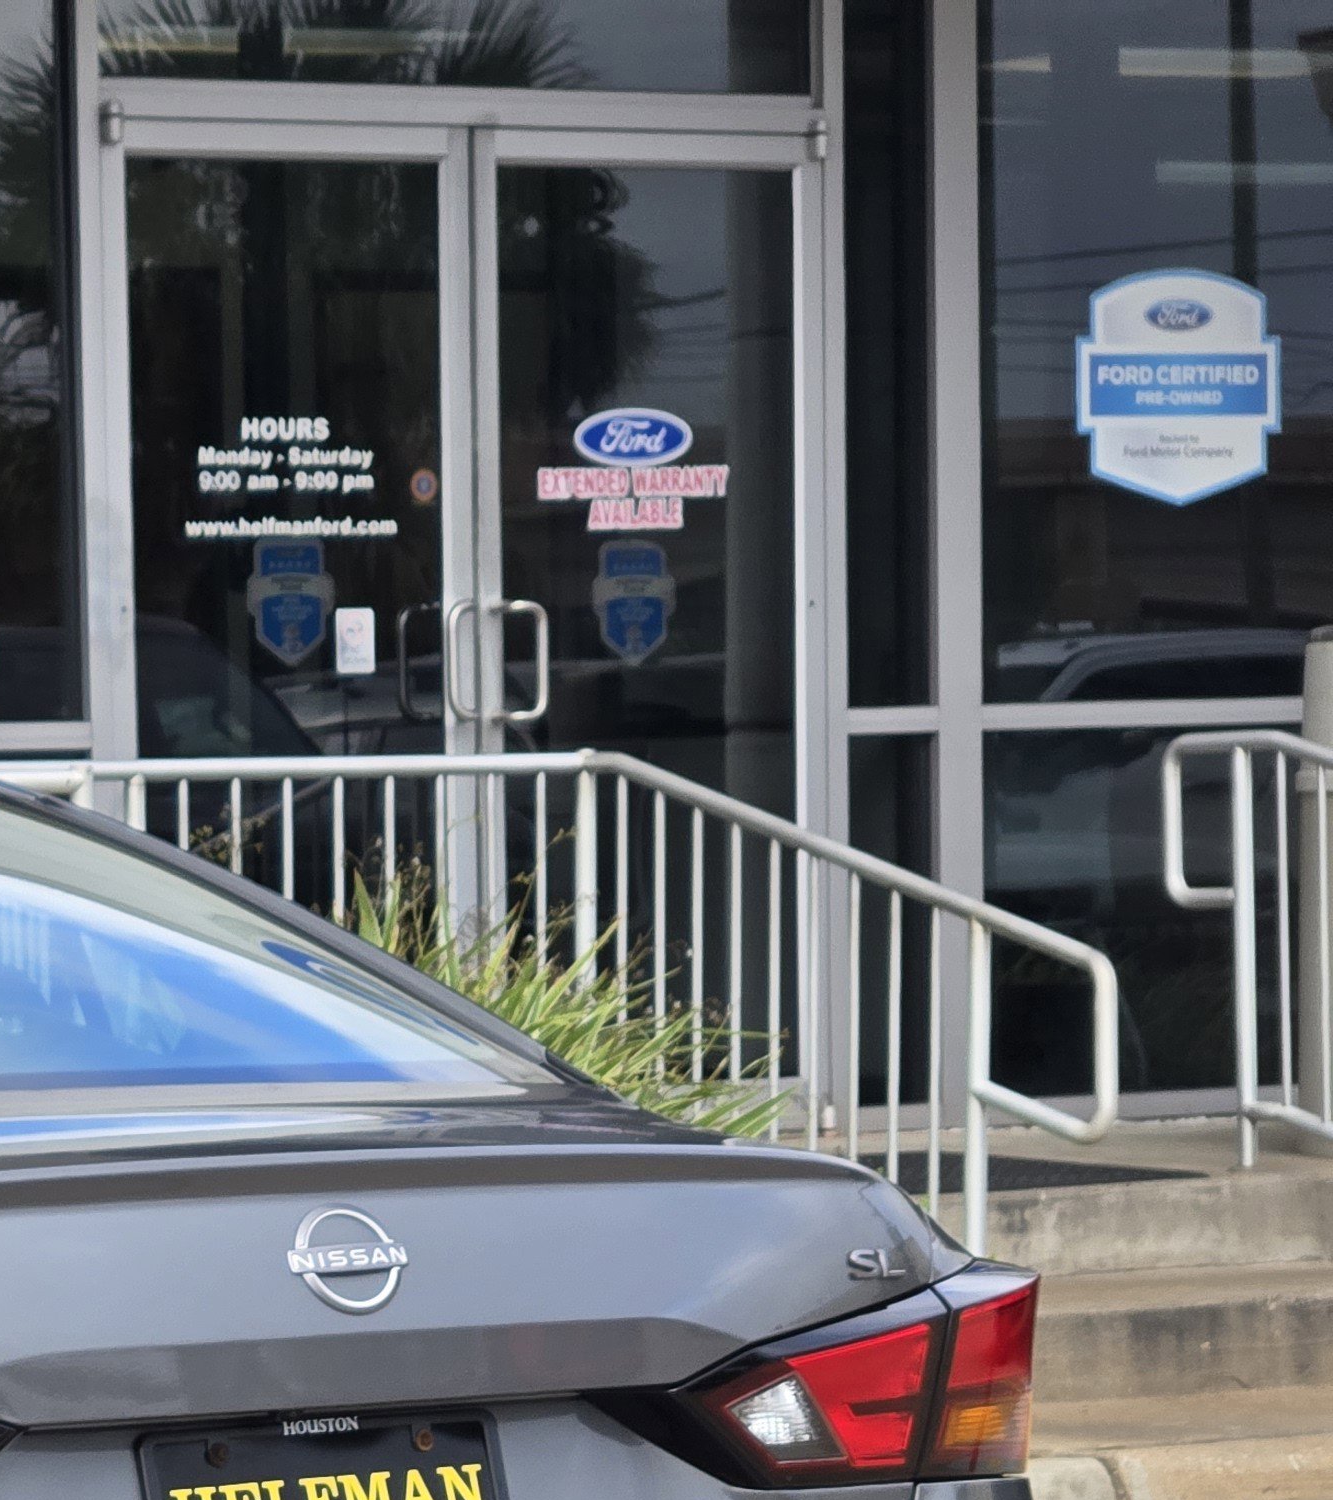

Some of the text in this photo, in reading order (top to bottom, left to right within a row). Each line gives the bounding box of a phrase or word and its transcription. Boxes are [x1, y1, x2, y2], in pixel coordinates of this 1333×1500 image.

[1156, 302, 1201, 326] Ford
[1097, 365, 1259, 385] FORD CERTIFIED
[1135, 390, 1223, 405] PRE-OWNED
[241, 417, 330, 441] HOURS
[599, 416, 667, 453] Ford
[198, 446, 273, 470] Monday
[288, 446, 374, 470] Saturday
[199, 470, 241, 491] 9:00
[247, 474, 279, 490] am
[294, 470, 338, 490] 9:00
[342, 474, 374, 494] pm
[538, 466, 729, 498] EXTENDED WARRANTY
[589, 498, 683, 529] AVAILABLE
[185, 516, 398, 537] www.helfmanford.com
[291, 1246, 408, 1270] NISSAN
[846, 1248, 906, 1280] SL
[282, 1415, 360, 1437] HOUSTON
